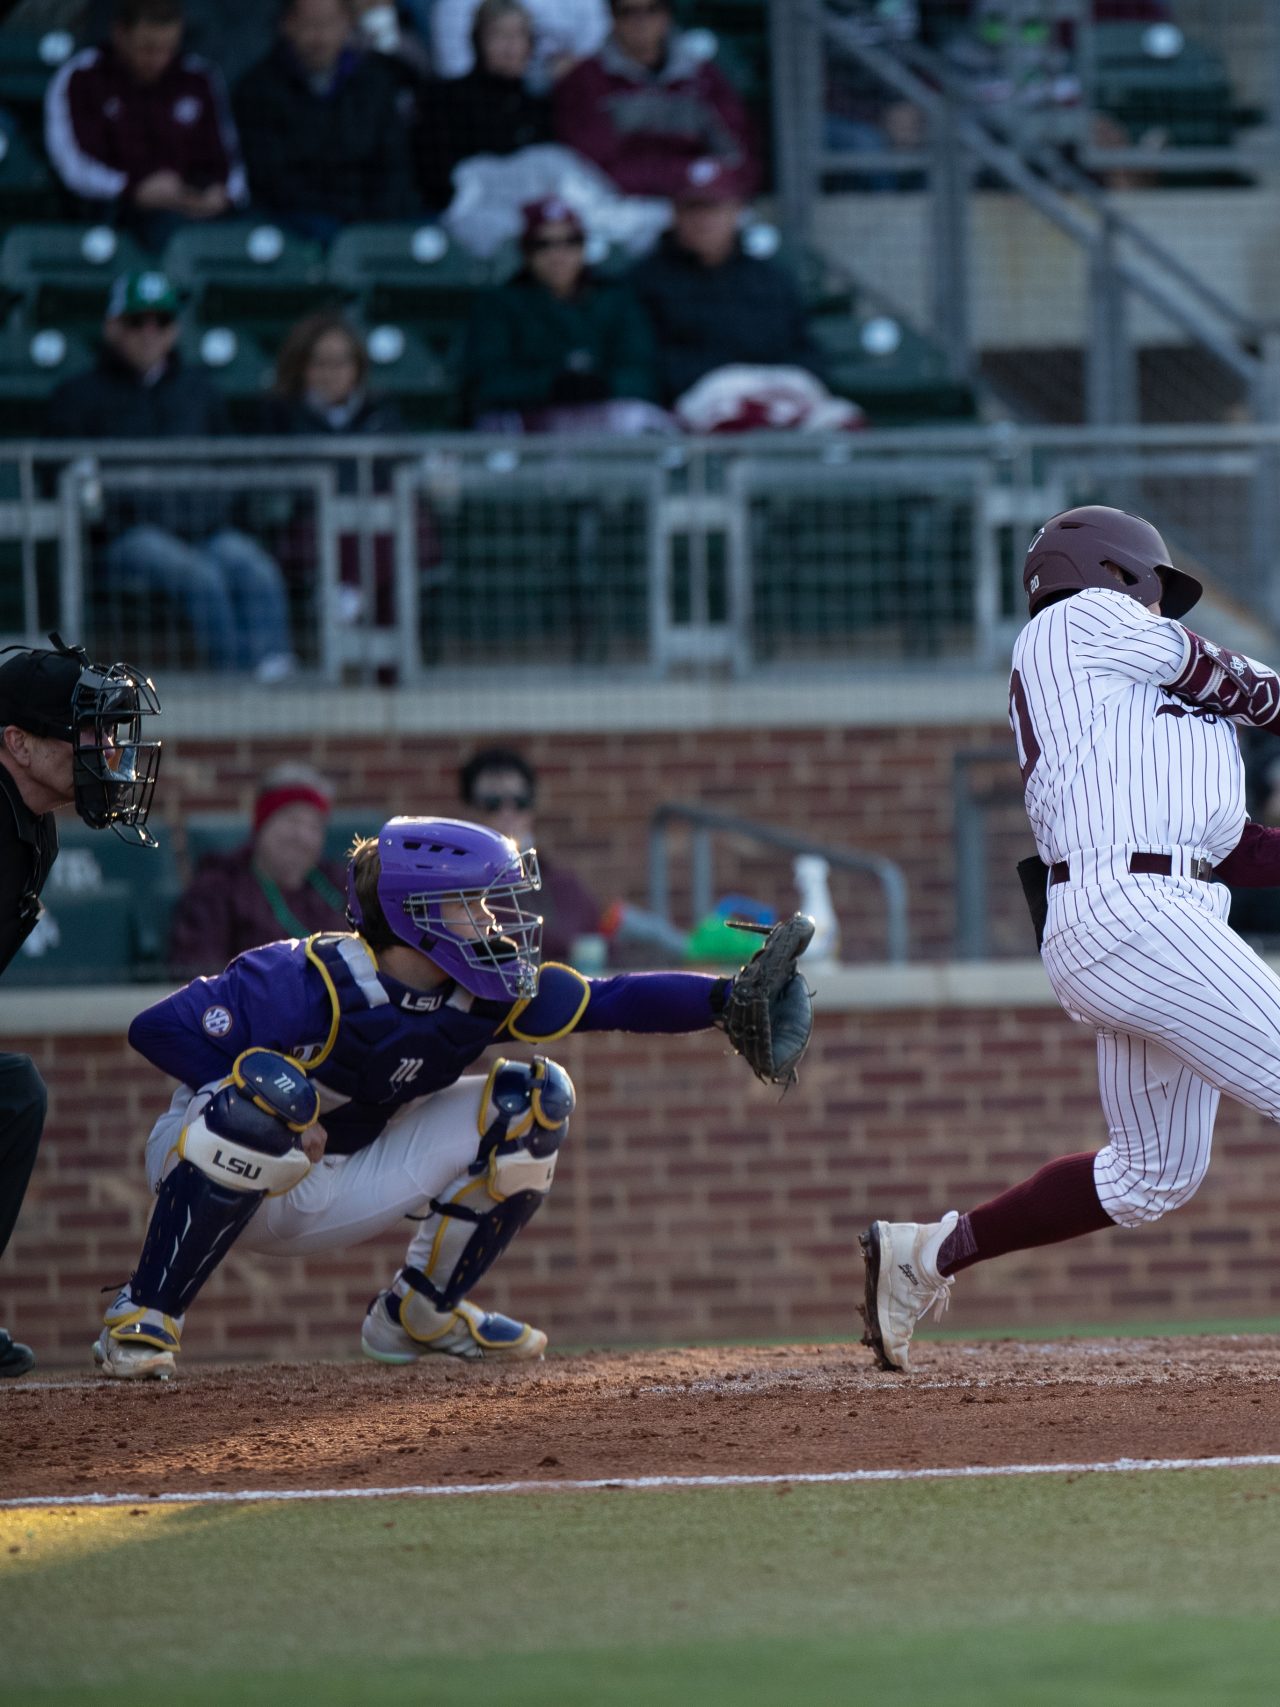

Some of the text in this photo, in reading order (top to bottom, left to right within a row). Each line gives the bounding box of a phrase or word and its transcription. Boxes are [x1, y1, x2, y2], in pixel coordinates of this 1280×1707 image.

[1029, 574, 1040, 594] 20
[400, 992, 443, 1012] LSU
[212, 1149, 262, 1180] LSU
